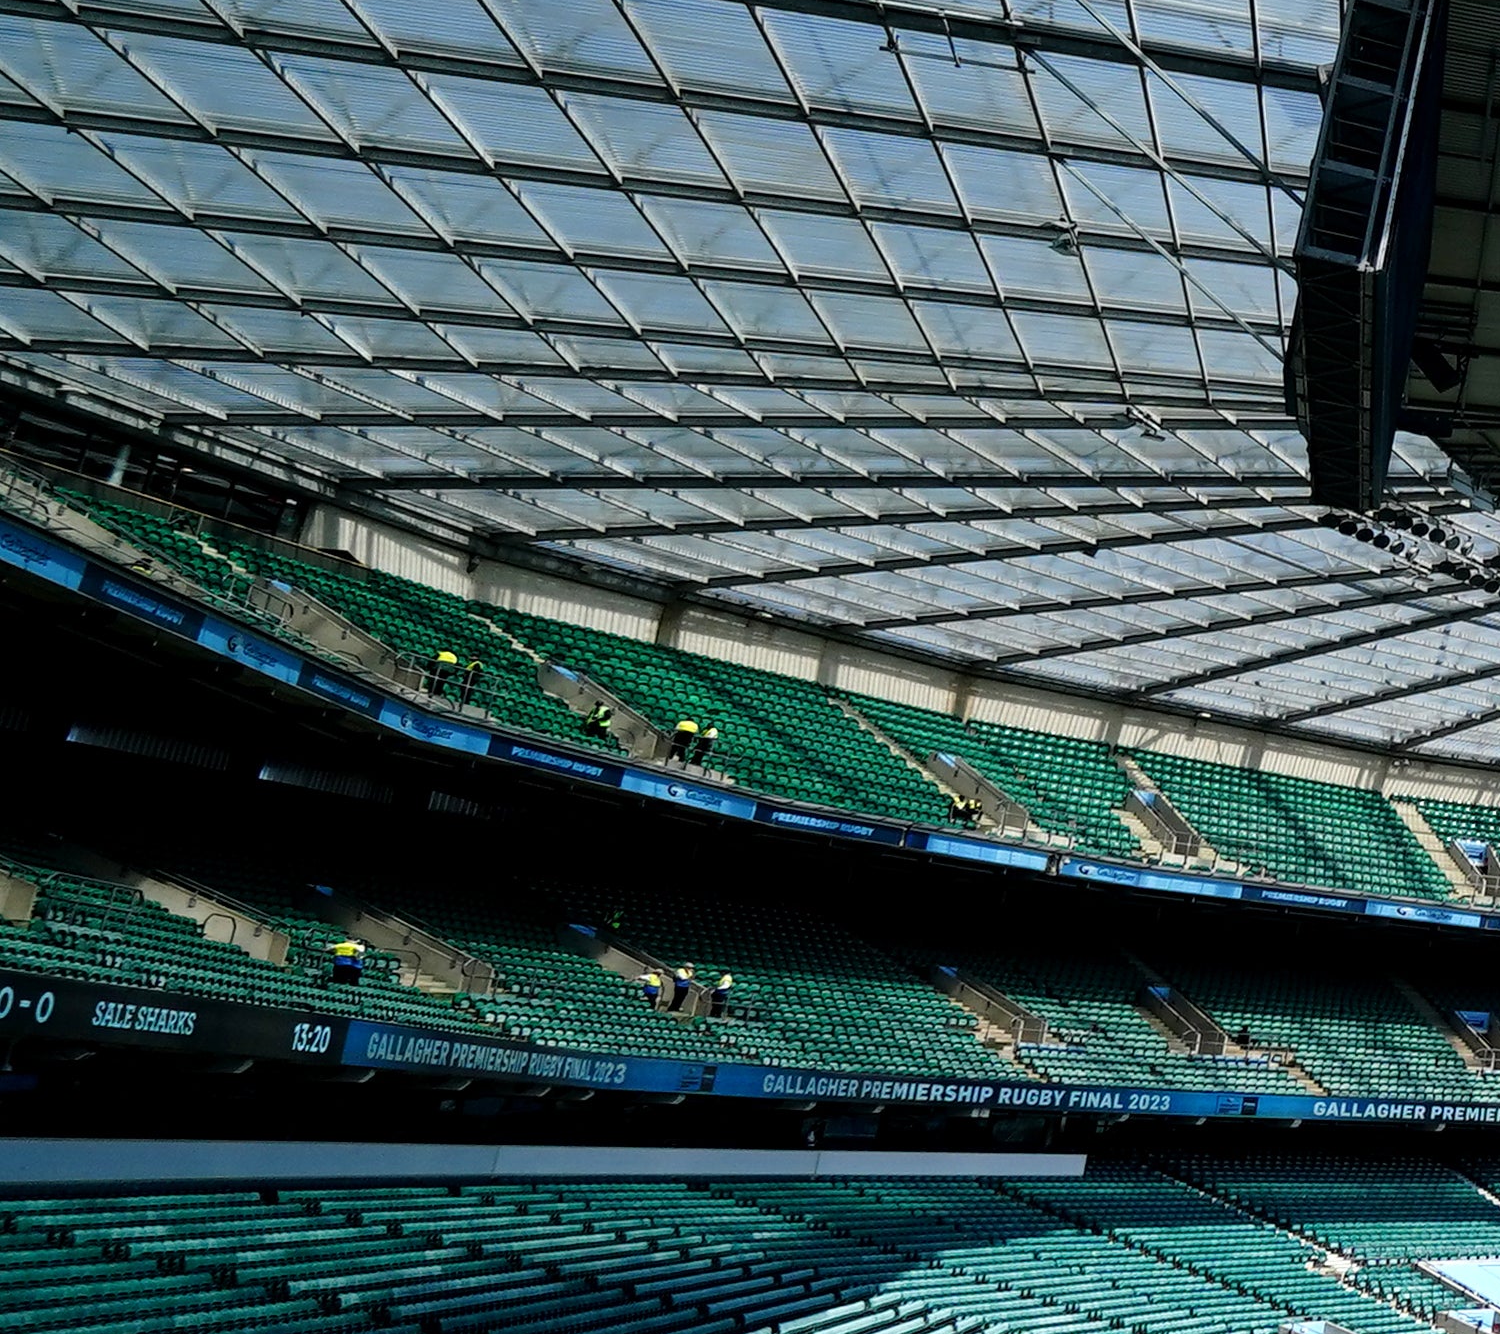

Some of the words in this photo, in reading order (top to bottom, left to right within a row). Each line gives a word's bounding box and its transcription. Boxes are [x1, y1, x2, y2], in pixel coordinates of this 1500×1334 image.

[92, 1000, 136, 1030] SALE
[137, 1005, 198, 1036] SHARKS
[292, 1022, 331, 1053] 13:20
[367, 1032, 450, 1066] GALLAGHER
[450, 1041, 530, 1076] PREMIERSHIP
[528, 1055, 567, 1080] RUGBY
[564, 1058, 592, 1082] FINAL
[591, 1061, 628, 1085] 2023
[763, 1072, 860, 1099] GALLAGHER
[860, 1078, 993, 1103] PREMIERSHIP
[998, 1086, 1065, 1107] RUGBY
[1069, 1091, 1124, 1111] FINAL
[1129, 1093, 1171, 1111] 2023
[1313, 1101, 1425, 1121] GALLAGHER
